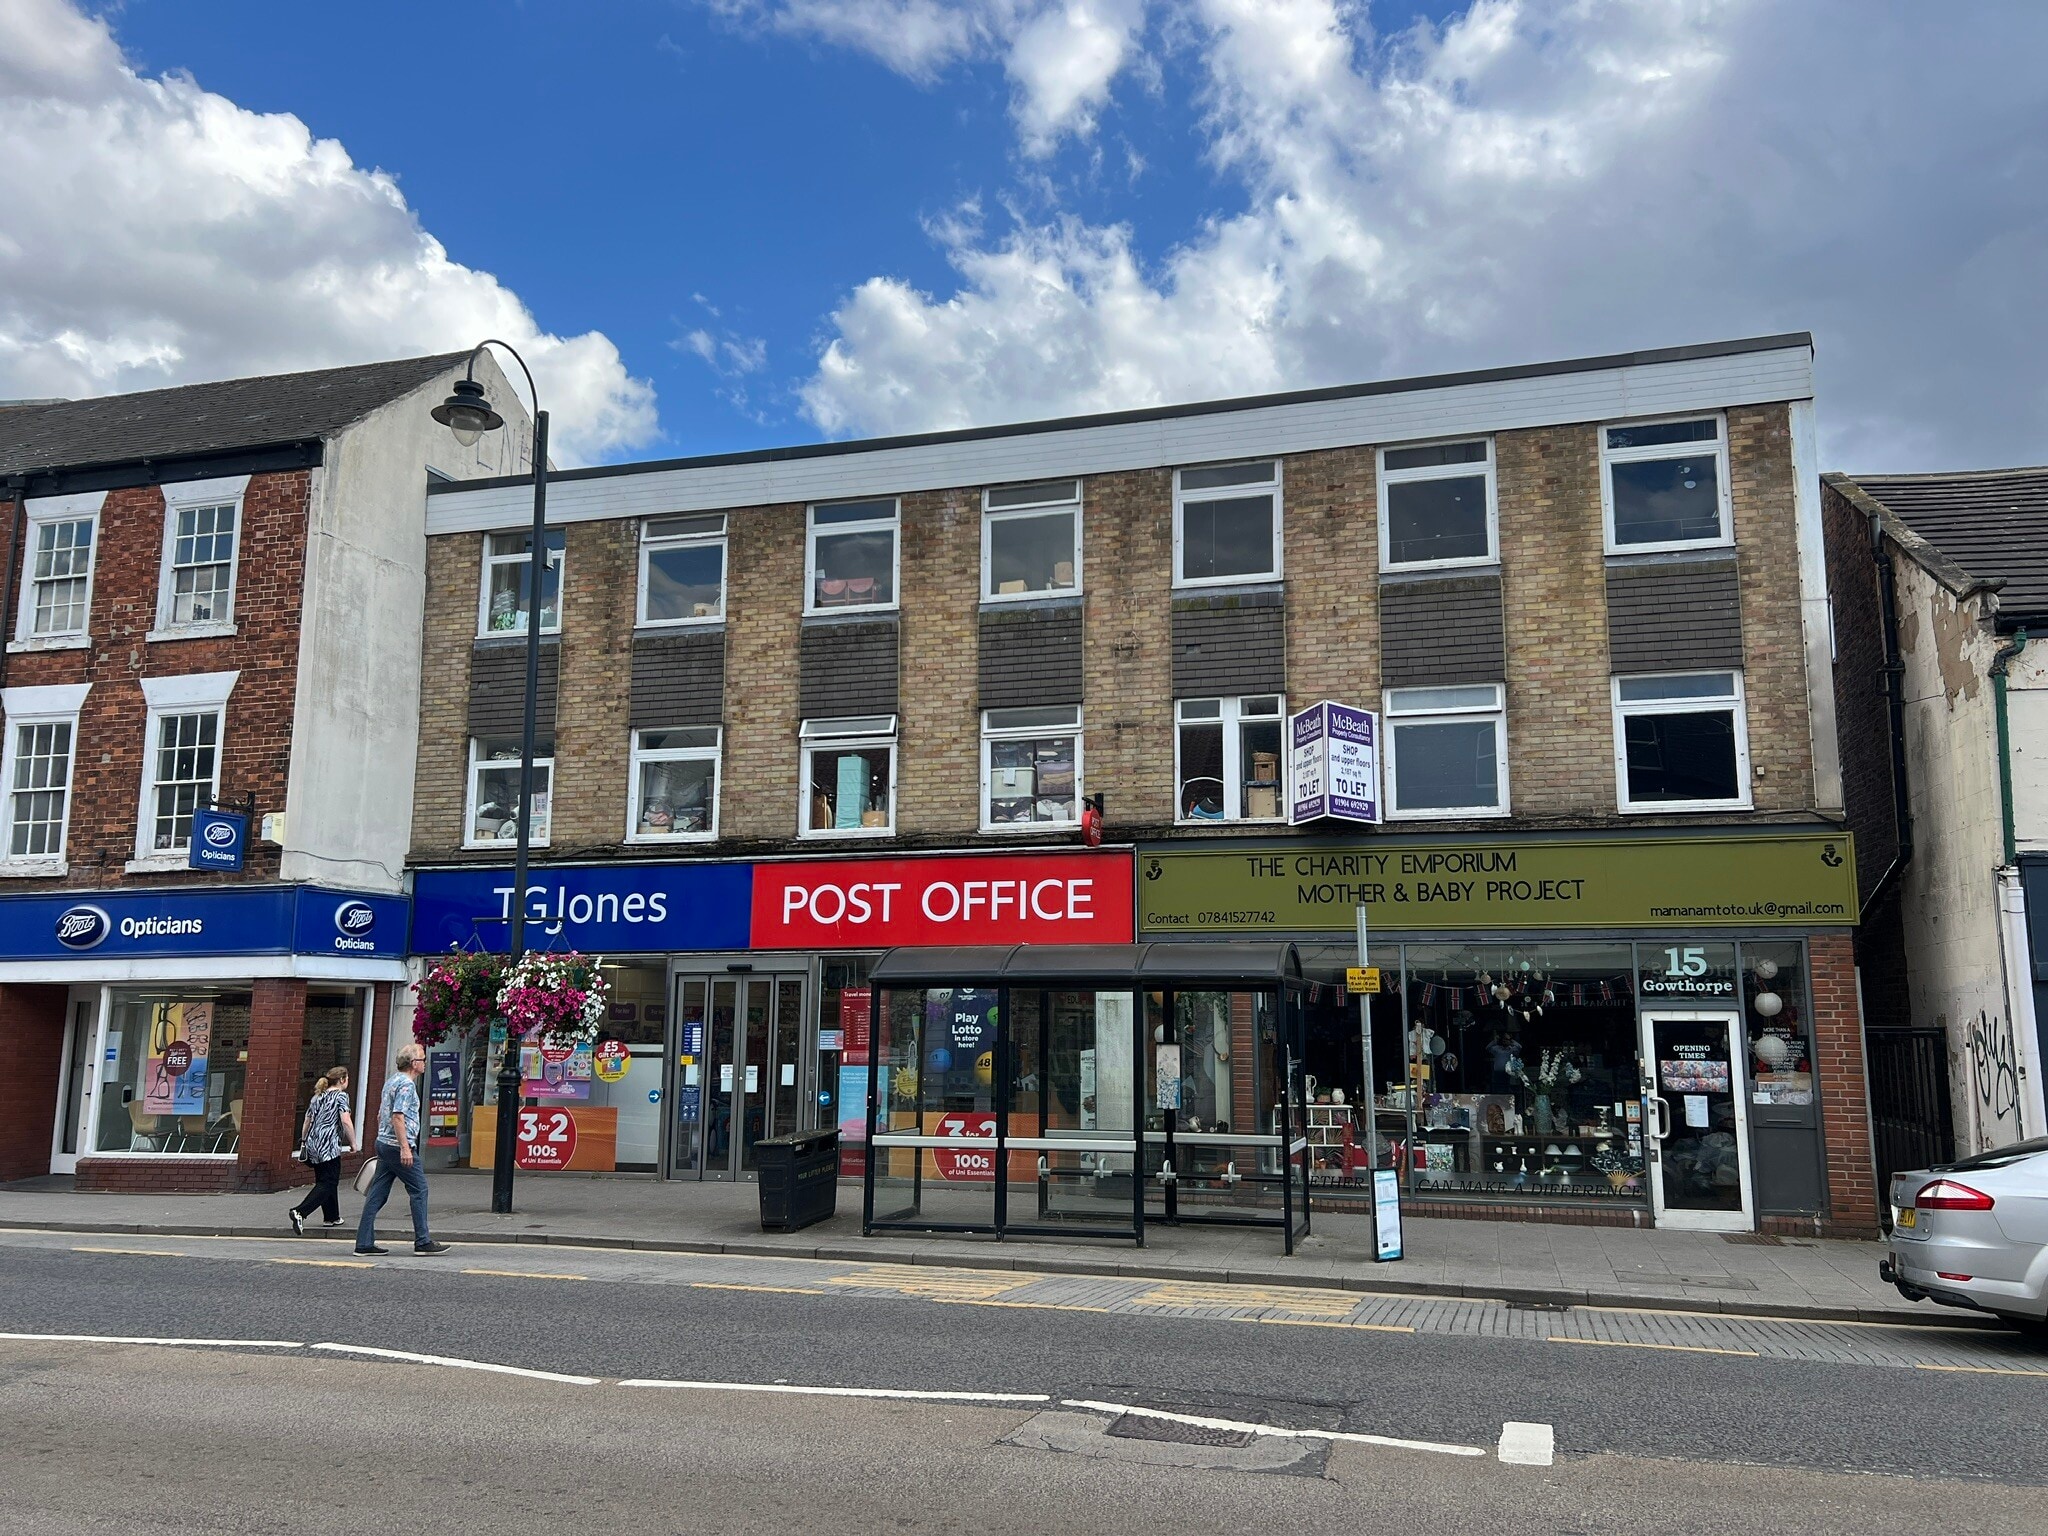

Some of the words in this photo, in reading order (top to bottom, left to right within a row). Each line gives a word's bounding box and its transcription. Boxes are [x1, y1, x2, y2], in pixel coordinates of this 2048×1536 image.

[1296, 712, 1321, 737] McBeath
[1332, 712, 1370, 735] McBeath
[1331, 727, 1348, 738] Property
[1348, 731, 1371, 744] Consultancy
[1303, 745, 1314, 758] SHOP
[1342, 744, 1358, 756] SHOP
[1303, 758, 1312, 770] upper
[1312, 754, 1322, 765] floors
[1331, 753, 1341, 763] and
[1341, 756, 1355, 768] upper
[1355, 757, 1371, 769] floors
[1299, 783, 1308, 799] TO
[1308, 779, 1320, 796] LET
[1336, 778, 1348, 794] TO
[1350, 781, 1367, 797] LET
[1334, 797, 1350, 808] 01904
[1091, 816, 1100, 829] POST
[208, 826, 231, 841] Boots
[1090, 826, 1101, 839] OFFICE
[201, 849, 235, 861] Opticians
[1246, 857, 1286, 877] THE
[1294, 855, 1389, 876] CHARITY
[1400, 852, 1517, 874] EMPORIUM
[1297, 884, 1386, 904] MOTHER
[1393, 883, 1410, 902] &
[1417, 881, 1475, 902] BABY
[1486, 879, 1585, 901] PROJECT
[782, 883, 902, 925] POST
[921, 879, 1094, 923] OFFICE
[1650, 901, 1845, 918] mamanamtoto.uk@gmail.com
[344, 909, 373, 928] Boots
[1147, 912, 1190, 924] Contact
[1198, 911, 1276, 924] 07841527742
[58, 914, 97, 938] Boots
[120, 916, 203, 939] Opticians
[335, 936, 375, 950] Opticians
[1664, 947, 1708, 977] 15
[1642, 979, 1733, 995] Gowthorpe
[955, 1012, 979, 1025] Play
[951, 1024, 982, 1035] Lotto
[604, 1041, 618, 1052] £5
[1672, 1044, 1711, 1052] OPENING
[167, 1056, 187, 1065] FREE
[978, 1059, 991, 1067] 48
[519, 1113, 538, 1142] 3
[538, 1122, 550, 1131] for
[548, 1113, 568, 1142] 2
[527, 1145, 557, 1157] 100s
[954, 1154, 989, 1168] 100s
[1418, 1178, 1453, 1192] CAN
[1459, 1180, 1508, 1194] MAKE
[1512, 1182, 1524, 1195] A
[1530, 1183, 1643, 1198] DIFFERENCE
